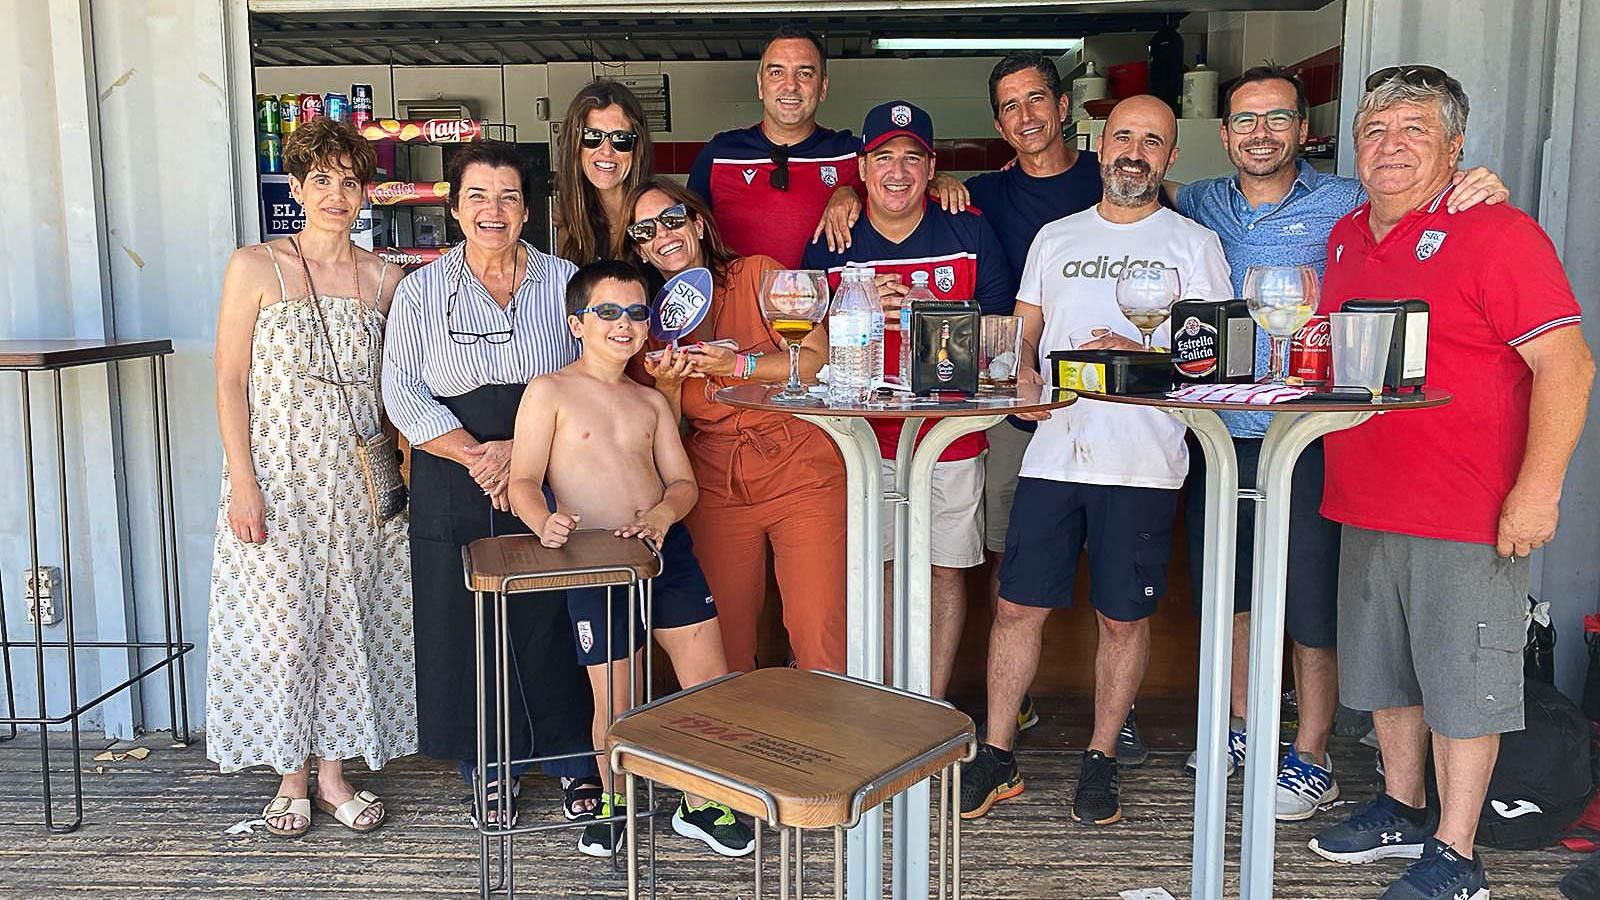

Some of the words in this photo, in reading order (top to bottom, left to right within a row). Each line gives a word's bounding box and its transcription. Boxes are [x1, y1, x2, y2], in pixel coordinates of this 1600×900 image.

[272, 204, 295, 217] EL
[272, 220, 289, 230] DE
[1062, 255, 1166, 279] adidas
[674, 282, 704, 309] SRC
[1177, 335, 1214, 351] Estrella
[1180, 347, 1214, 361] Galicia
[669, 716, 753, 742] 1906
